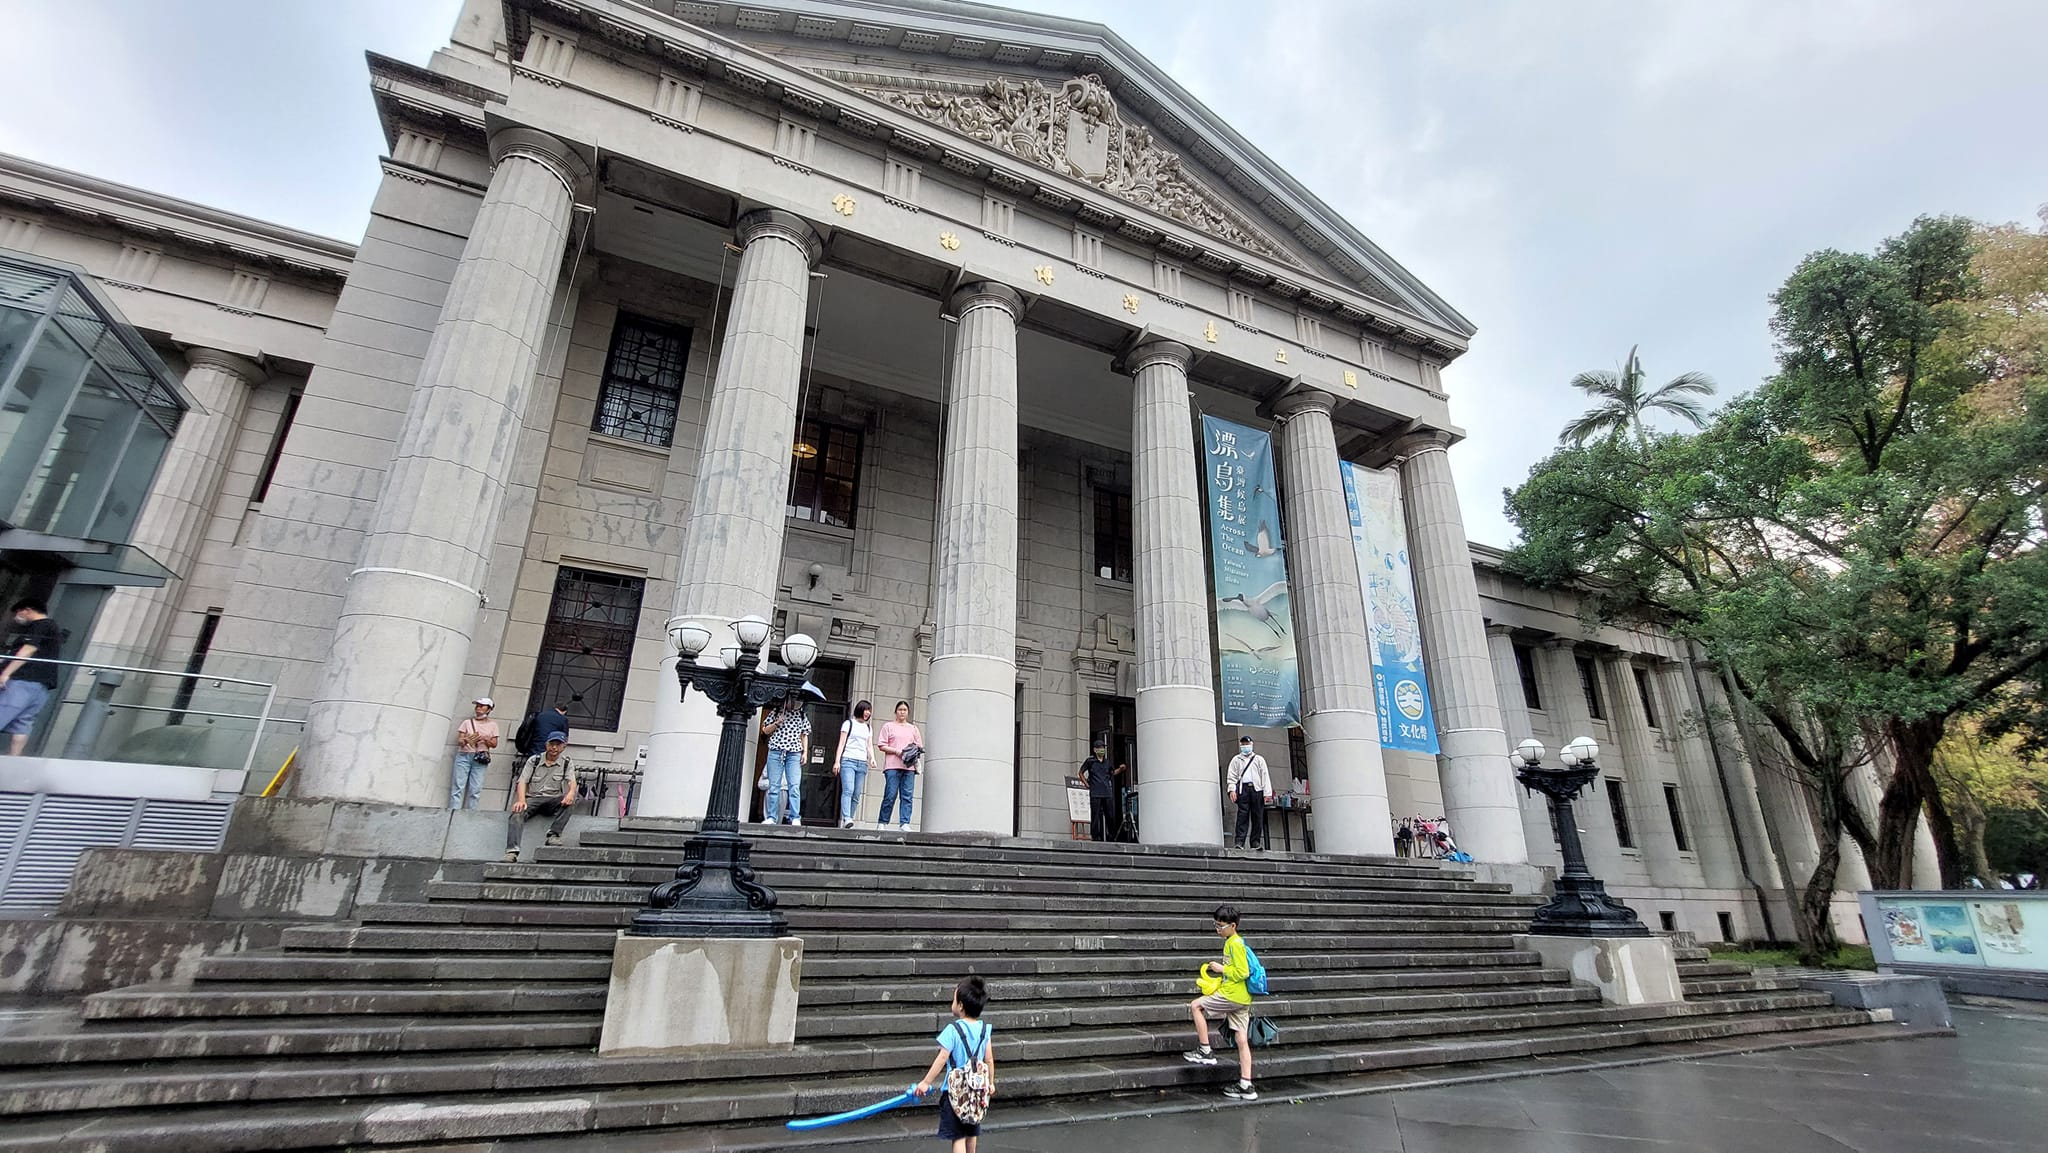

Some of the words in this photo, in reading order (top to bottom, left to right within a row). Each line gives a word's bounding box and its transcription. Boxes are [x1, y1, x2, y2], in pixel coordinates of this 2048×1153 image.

[1209, 428, 1239, 521] 漂鳥集
[1221, 523, 1246, 537] Across
[1221, 532, 1234, 543] The
[1221, 542, 1244, 556] Ocean
